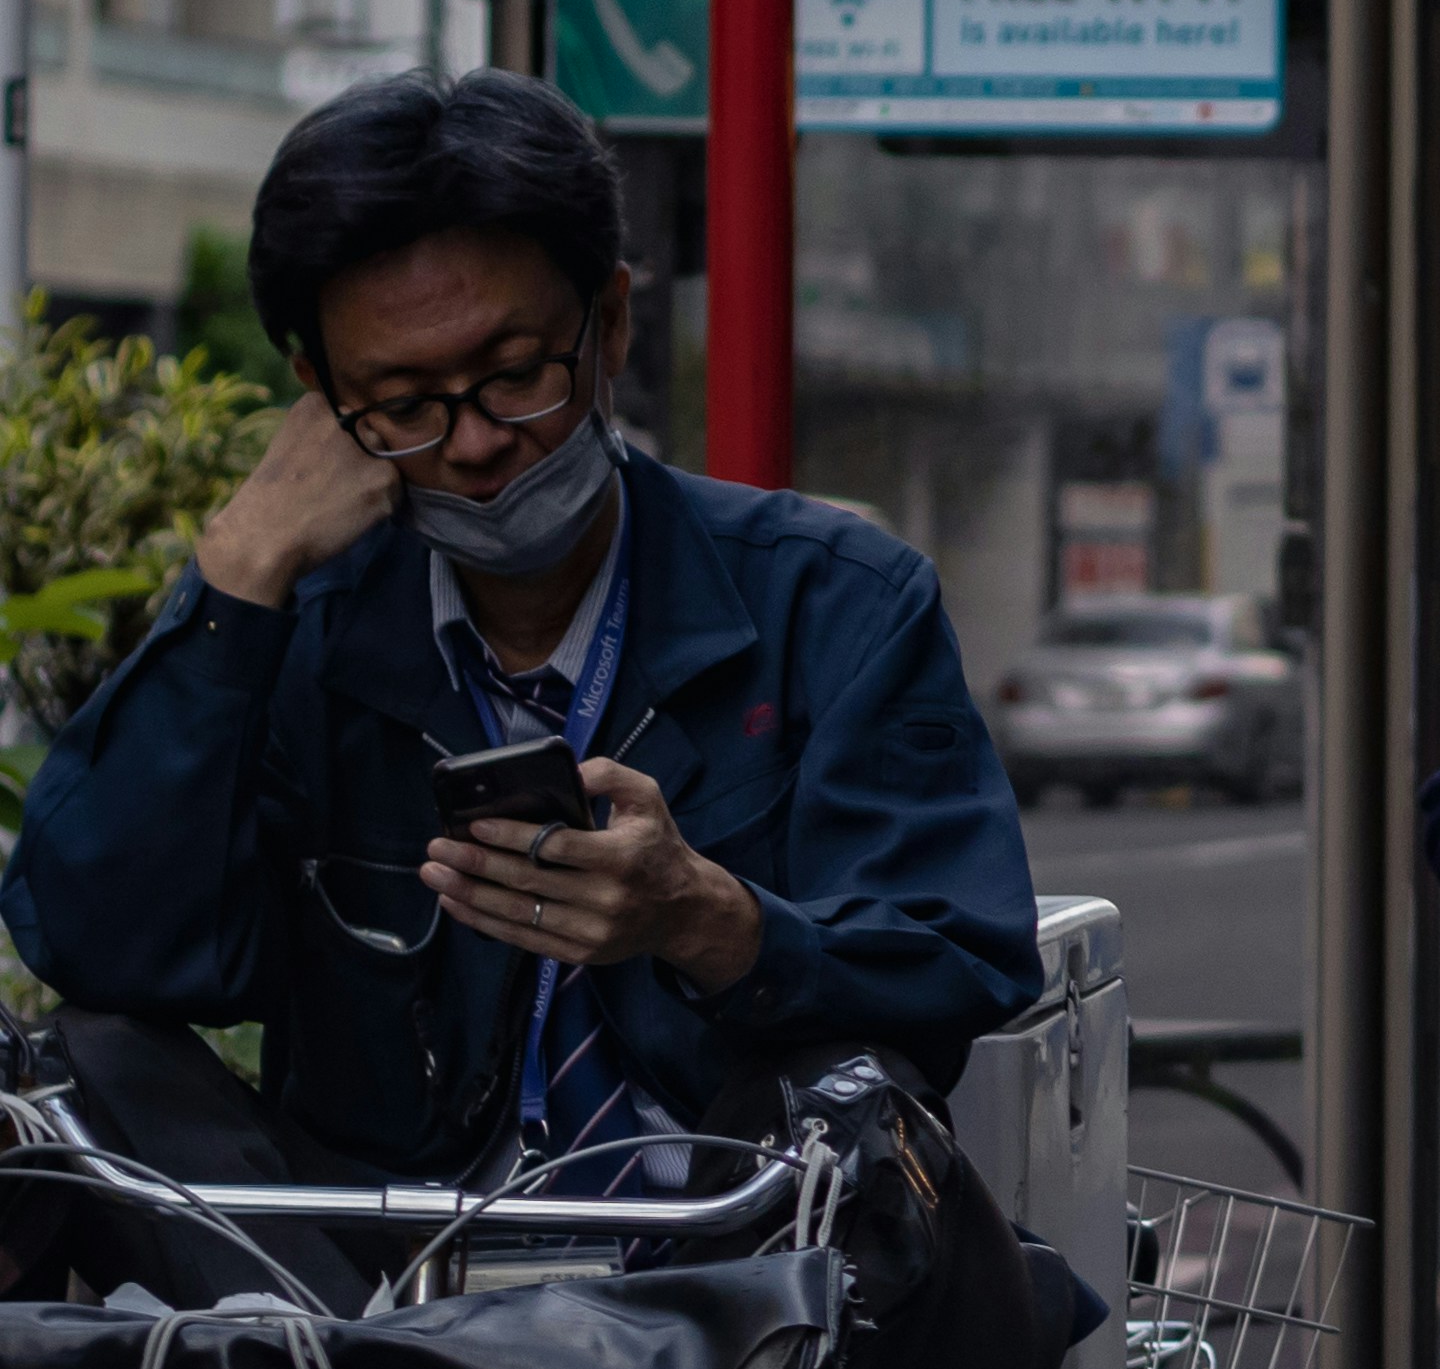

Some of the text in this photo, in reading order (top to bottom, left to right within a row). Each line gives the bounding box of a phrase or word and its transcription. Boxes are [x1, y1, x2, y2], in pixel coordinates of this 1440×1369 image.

[996, 16, 1145, 47] available
[577, 577, 631, 719] Microsoft Teams
